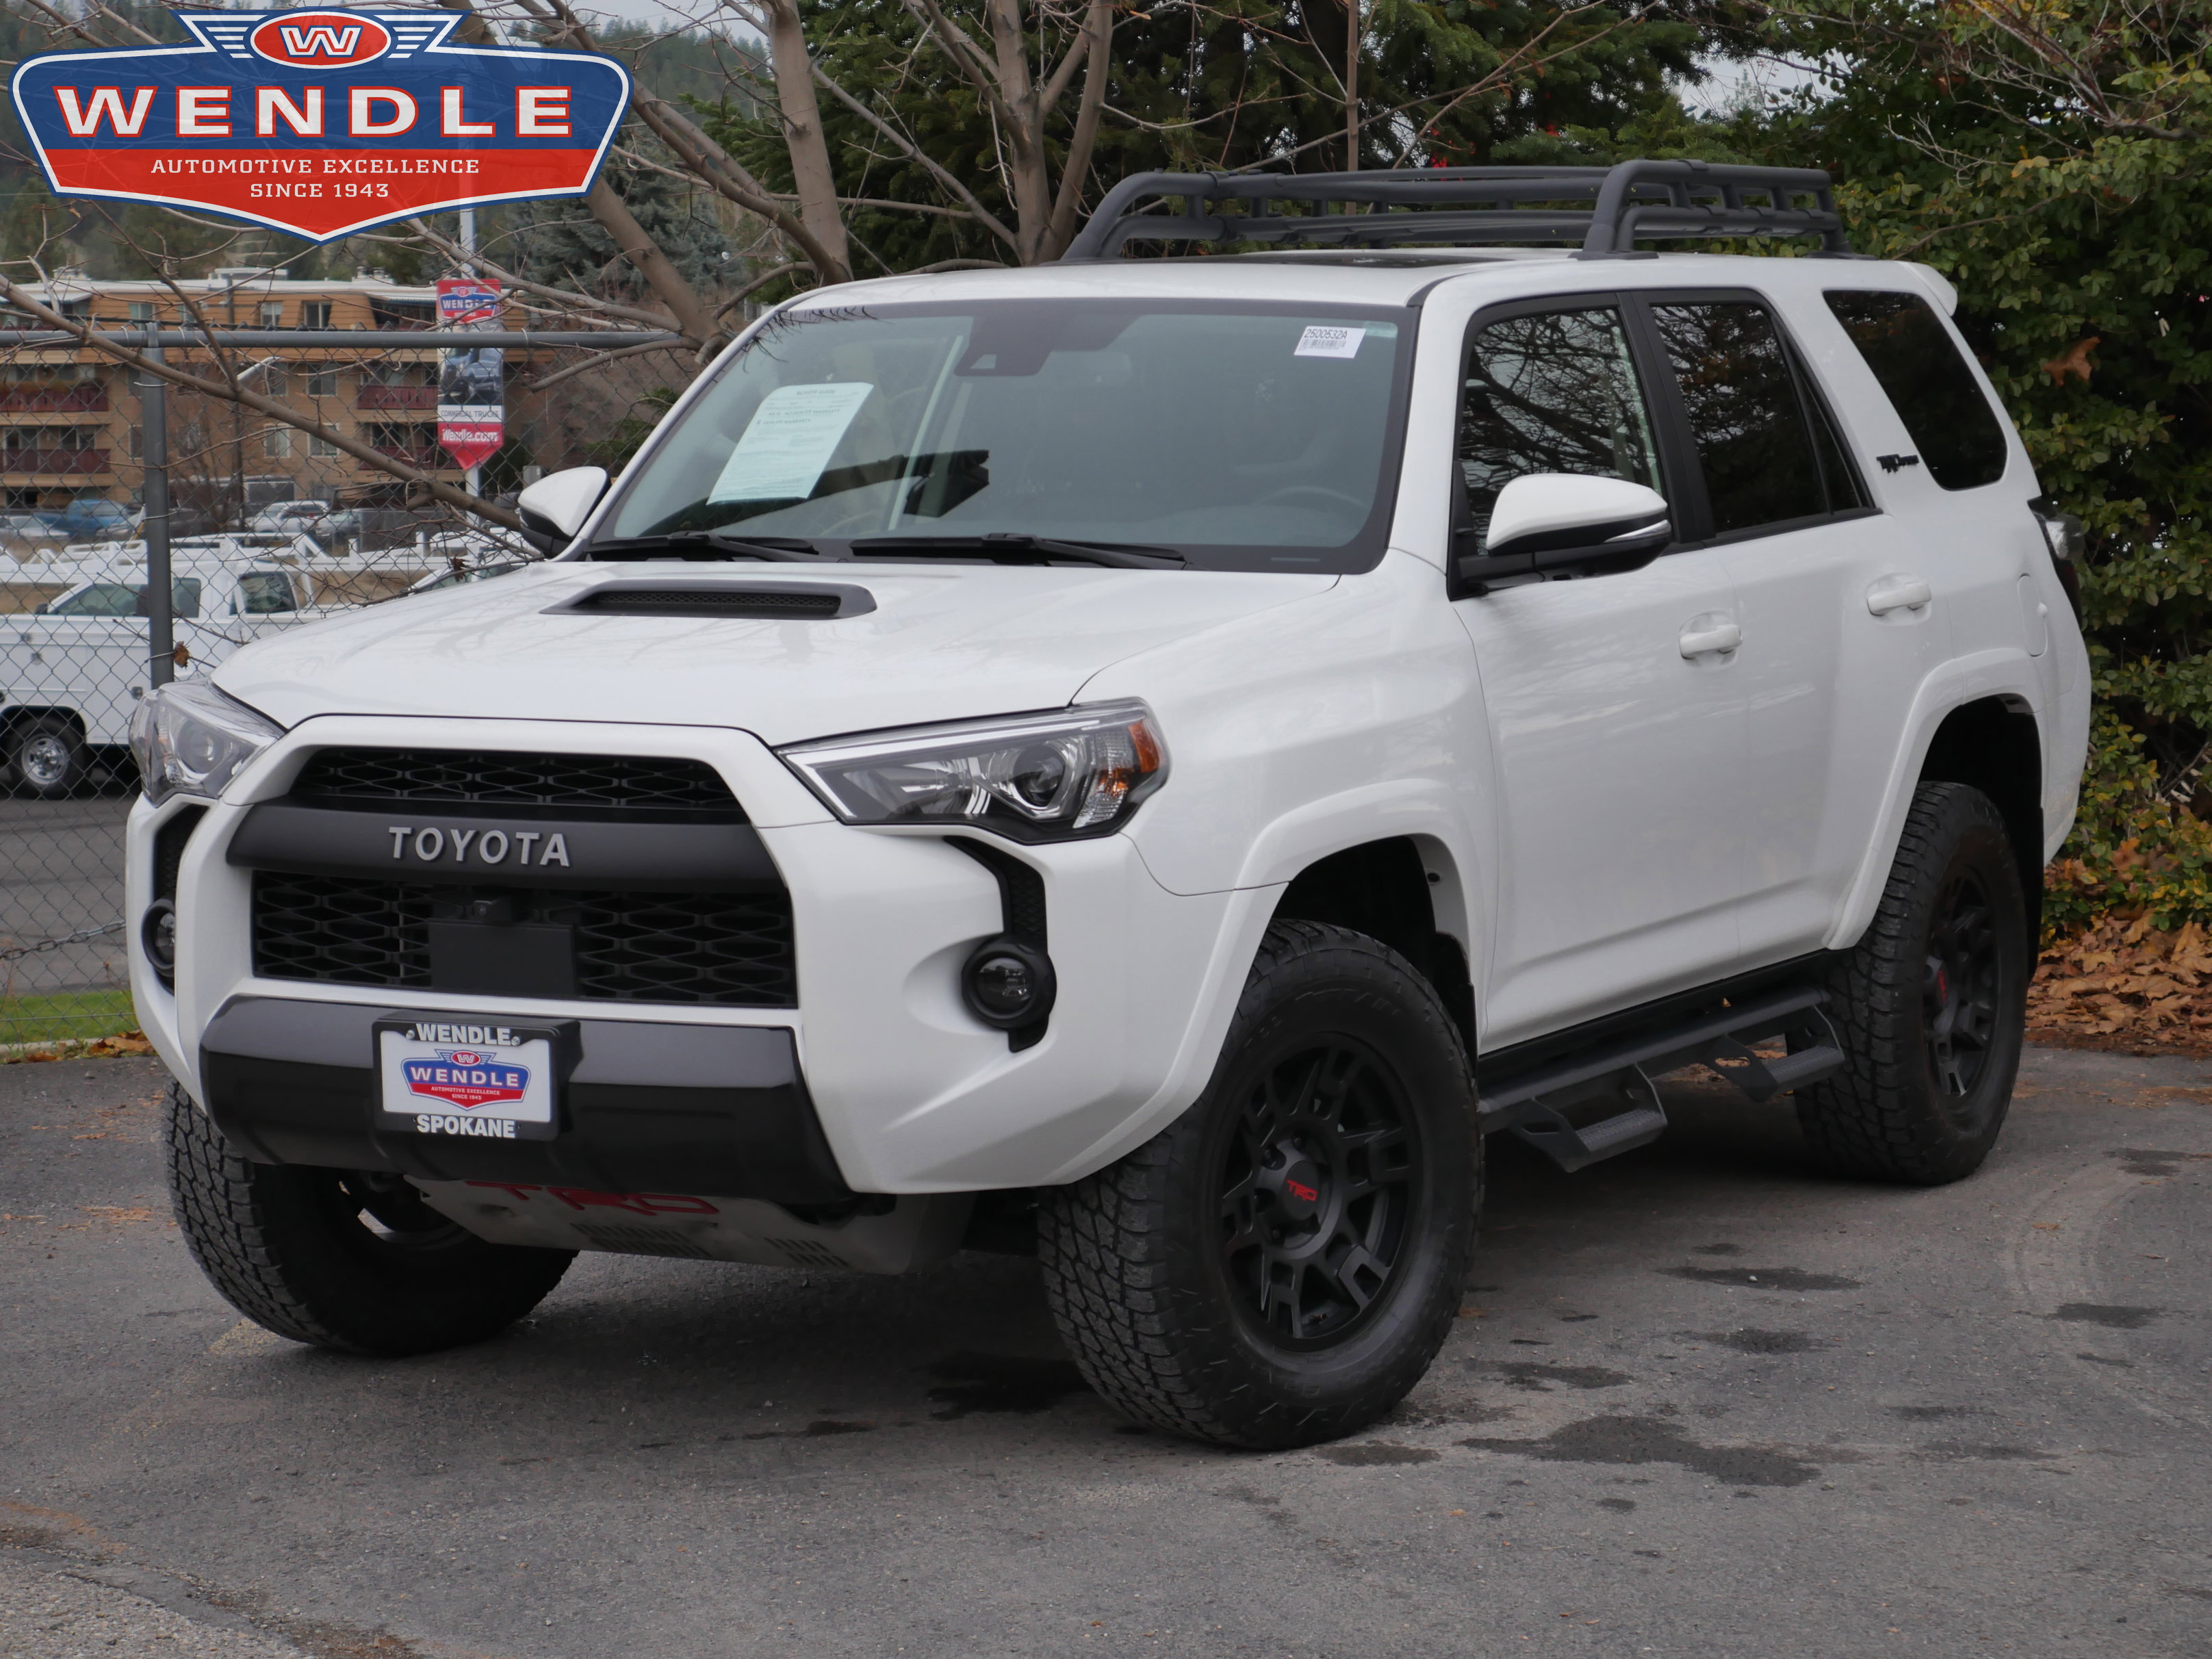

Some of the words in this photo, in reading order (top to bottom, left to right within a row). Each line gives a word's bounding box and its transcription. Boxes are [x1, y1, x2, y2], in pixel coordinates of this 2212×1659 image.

[1303, 329, 1348, 339] 2500532A
[388, 826, 570, 867] TOYOTA
[415, 1023, 512, 1046] WENDLE
[410, 1066, 519, 1087] WENDLE
[416, 1114, 516, 1139] SPOKANE
[465, 1180, 719, 1217] TRD
[1286, 1179, 1318, 1202] TRD
